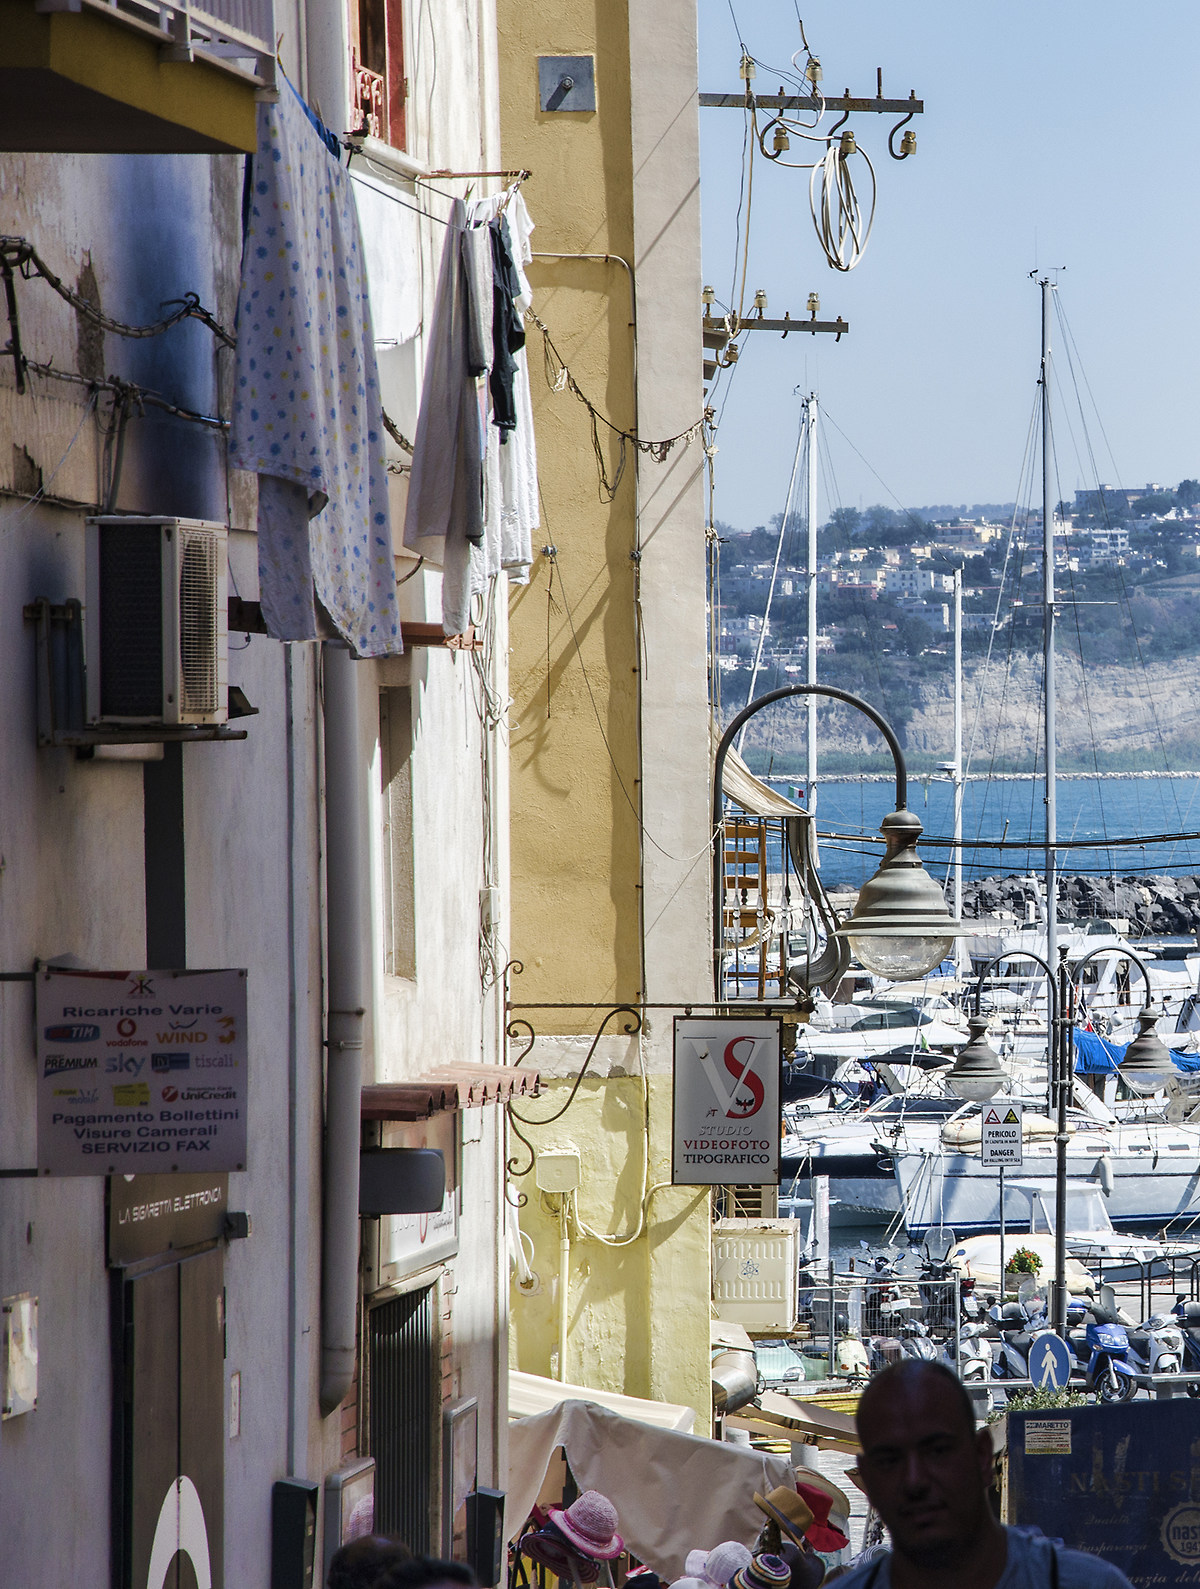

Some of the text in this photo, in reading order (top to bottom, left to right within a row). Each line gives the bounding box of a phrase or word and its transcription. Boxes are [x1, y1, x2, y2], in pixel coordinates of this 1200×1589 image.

[62, 1004, 223, 1018] Ricariche Varie
[71, 1026, 95, 1038] TIM
[155, 1031, 208, 1044] WIND
[106, 1038, 148, 1047] vodafone
[44, 1057, 98, 1069] PREMIUM
[105, 1052, 146, 1077] sky
[181, 1090, 237, 1101] UniCredit
[52, 1109, 240, 1126] Pagamento Bollettini
[73, 1124, 218, 1139] Visure Camerali
[699, 1125, 753, 1136] STUDIO
[81, 1140, 211, 1154] SERVIZIO FAX
[683, 1139, 771, 1150] VIDEOFOTO
[683, 1153, 771, 1164] TIPOGRAFICO
[118, 1207, 131, 1225] LA
[132, 1199, 173, 1222] SIGARETTA
